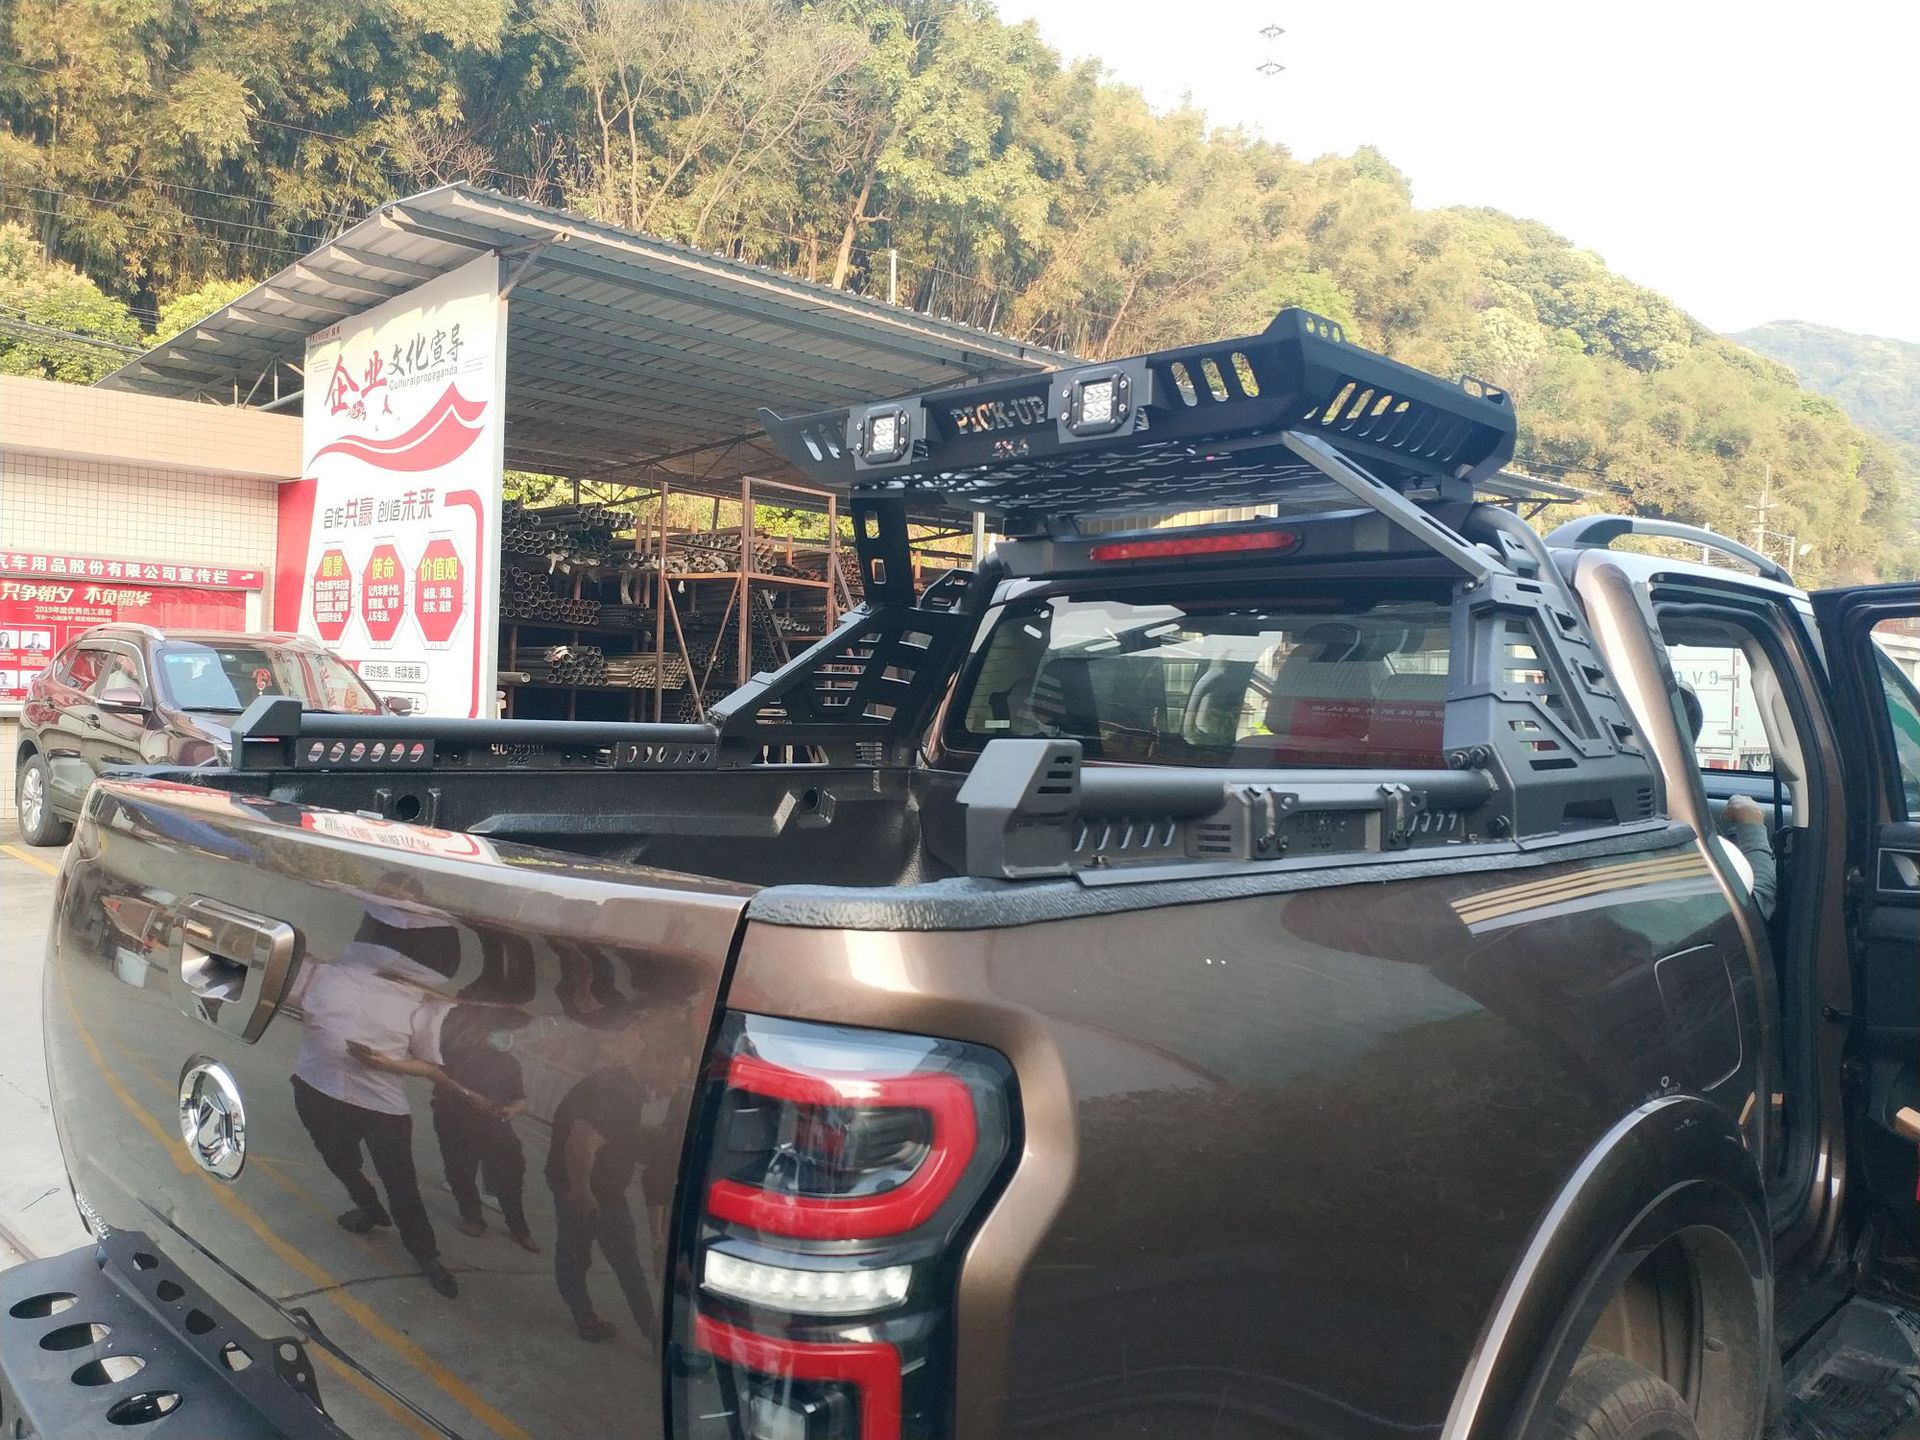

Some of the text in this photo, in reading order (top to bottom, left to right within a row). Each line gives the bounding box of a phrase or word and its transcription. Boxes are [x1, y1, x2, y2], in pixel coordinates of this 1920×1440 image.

[325, 323, 464, 415] 企业文化宣导
[950, 396, 1046, 434] PICK-UP
[324, 488, 435, 529] 合作共赢 创造未来
[322, 556, 343, 577] 愿景
[372, 556, 395, 580] 使命
[420, 557, 457, 582] 价值观
[1, 582, 152, 607] 只争朝夕 不负韶华
